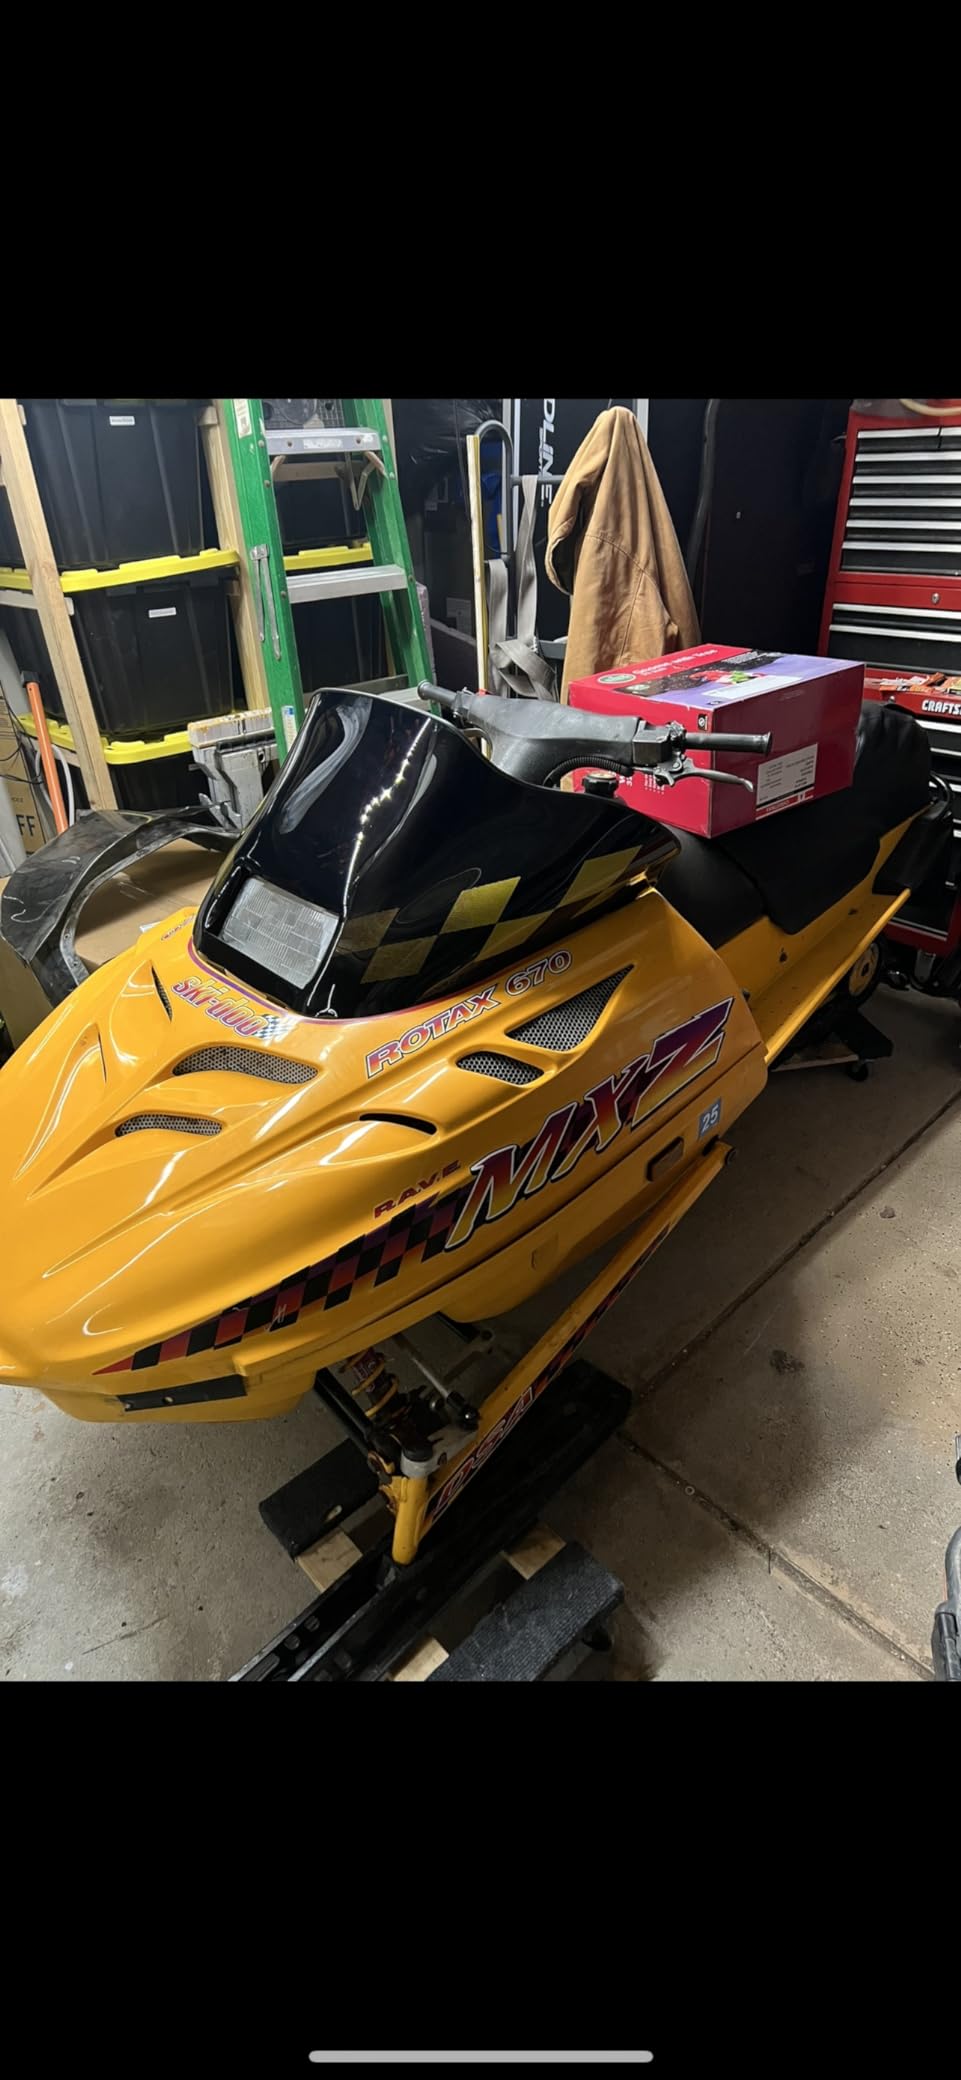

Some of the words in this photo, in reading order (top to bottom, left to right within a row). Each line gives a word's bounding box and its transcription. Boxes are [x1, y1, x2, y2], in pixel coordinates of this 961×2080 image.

[921, 699, 961, 716] CRAFTS
[366, 982, 502, 1079] ROTAX
[505, 950, 571, 996] 670
[444, 996, 734, 1250] MXZ
[700, 1103, 719, 1134] 25
